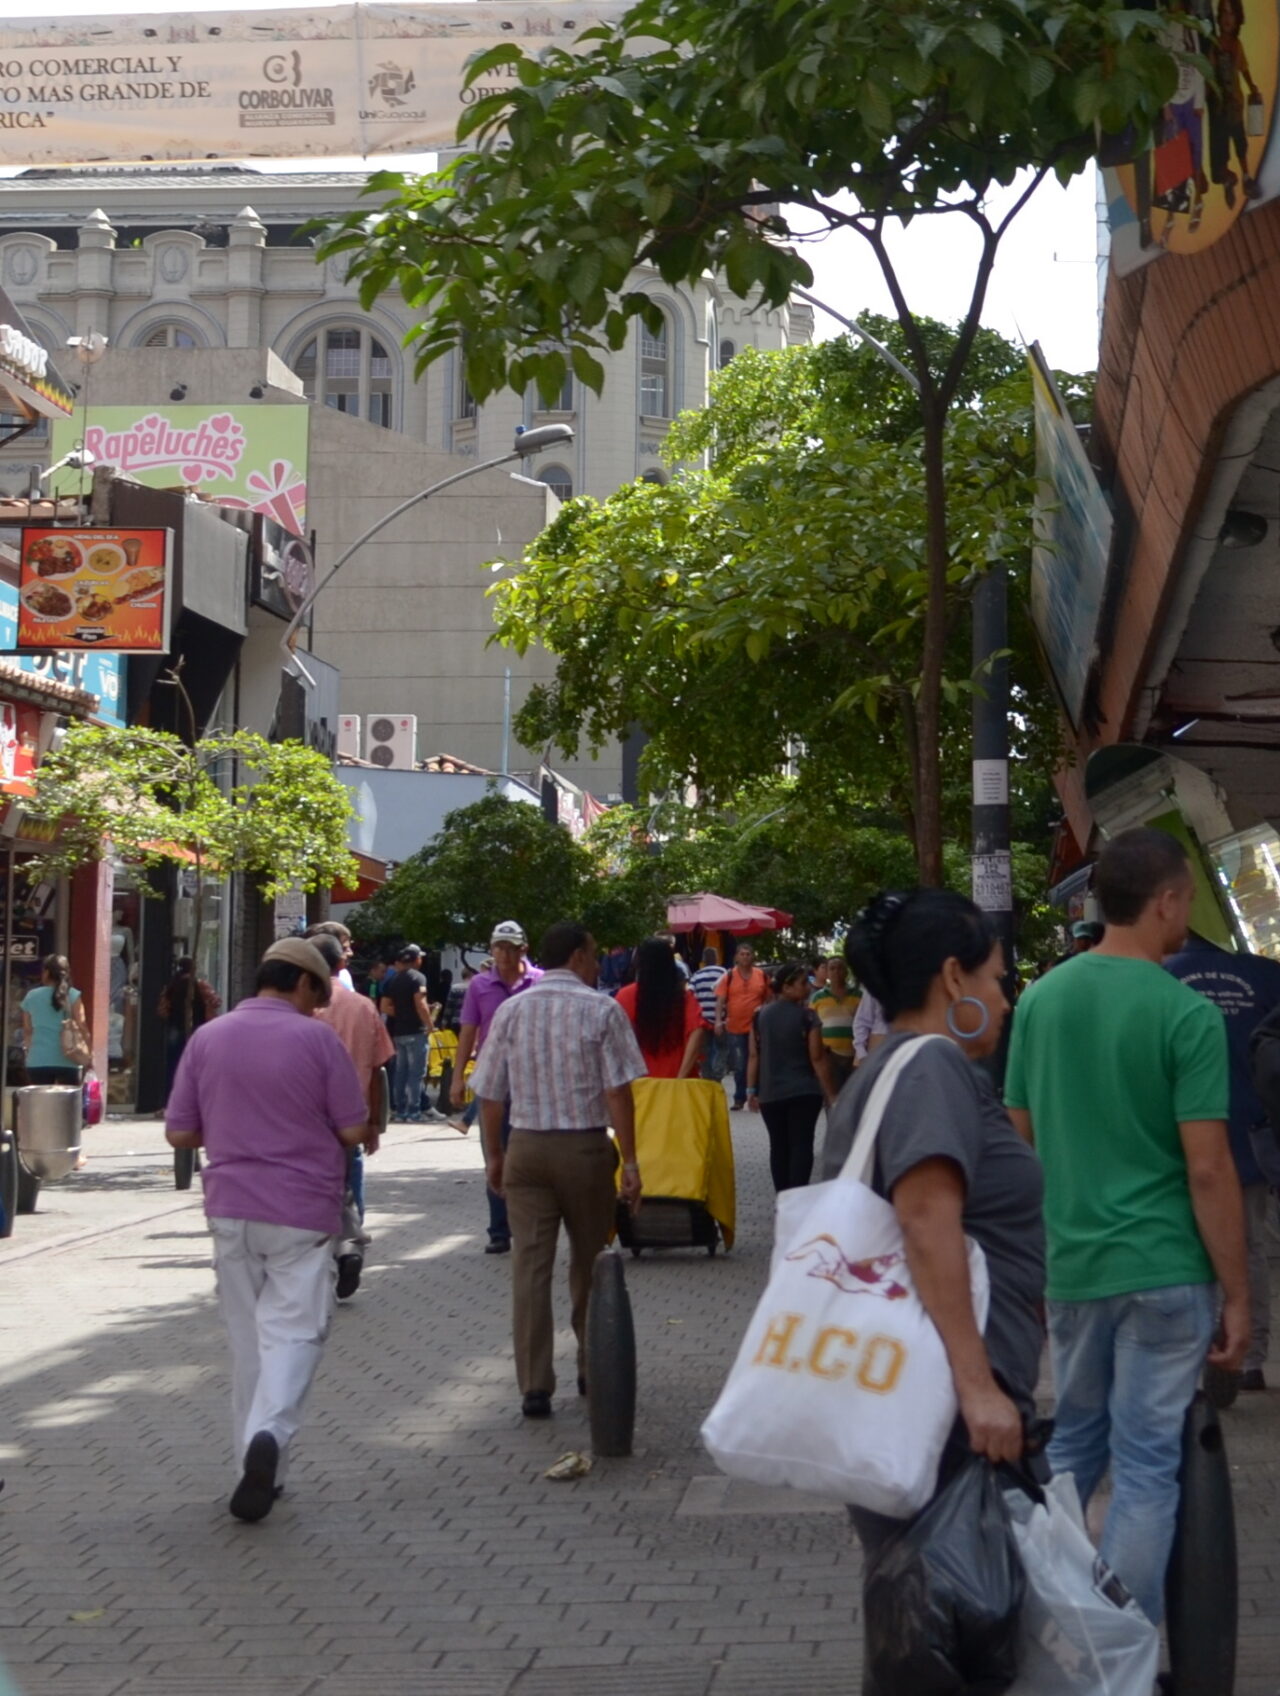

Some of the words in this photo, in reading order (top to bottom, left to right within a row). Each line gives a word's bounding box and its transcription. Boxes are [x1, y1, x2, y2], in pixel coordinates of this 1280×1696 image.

[29, 56, 163, 77] COMERCIAL
[167, 56, 182, 73] Y
[27, 85, 74, 103] MAS
[80, 82, 174, 101] GRANDE
[180, 82, 211, 99] DE
[238, 88, 334, 109] CORBOLIVAR
[86, 421, 244, 469] Rapeluches
[752, 1311, 908, 1396] H.CO
